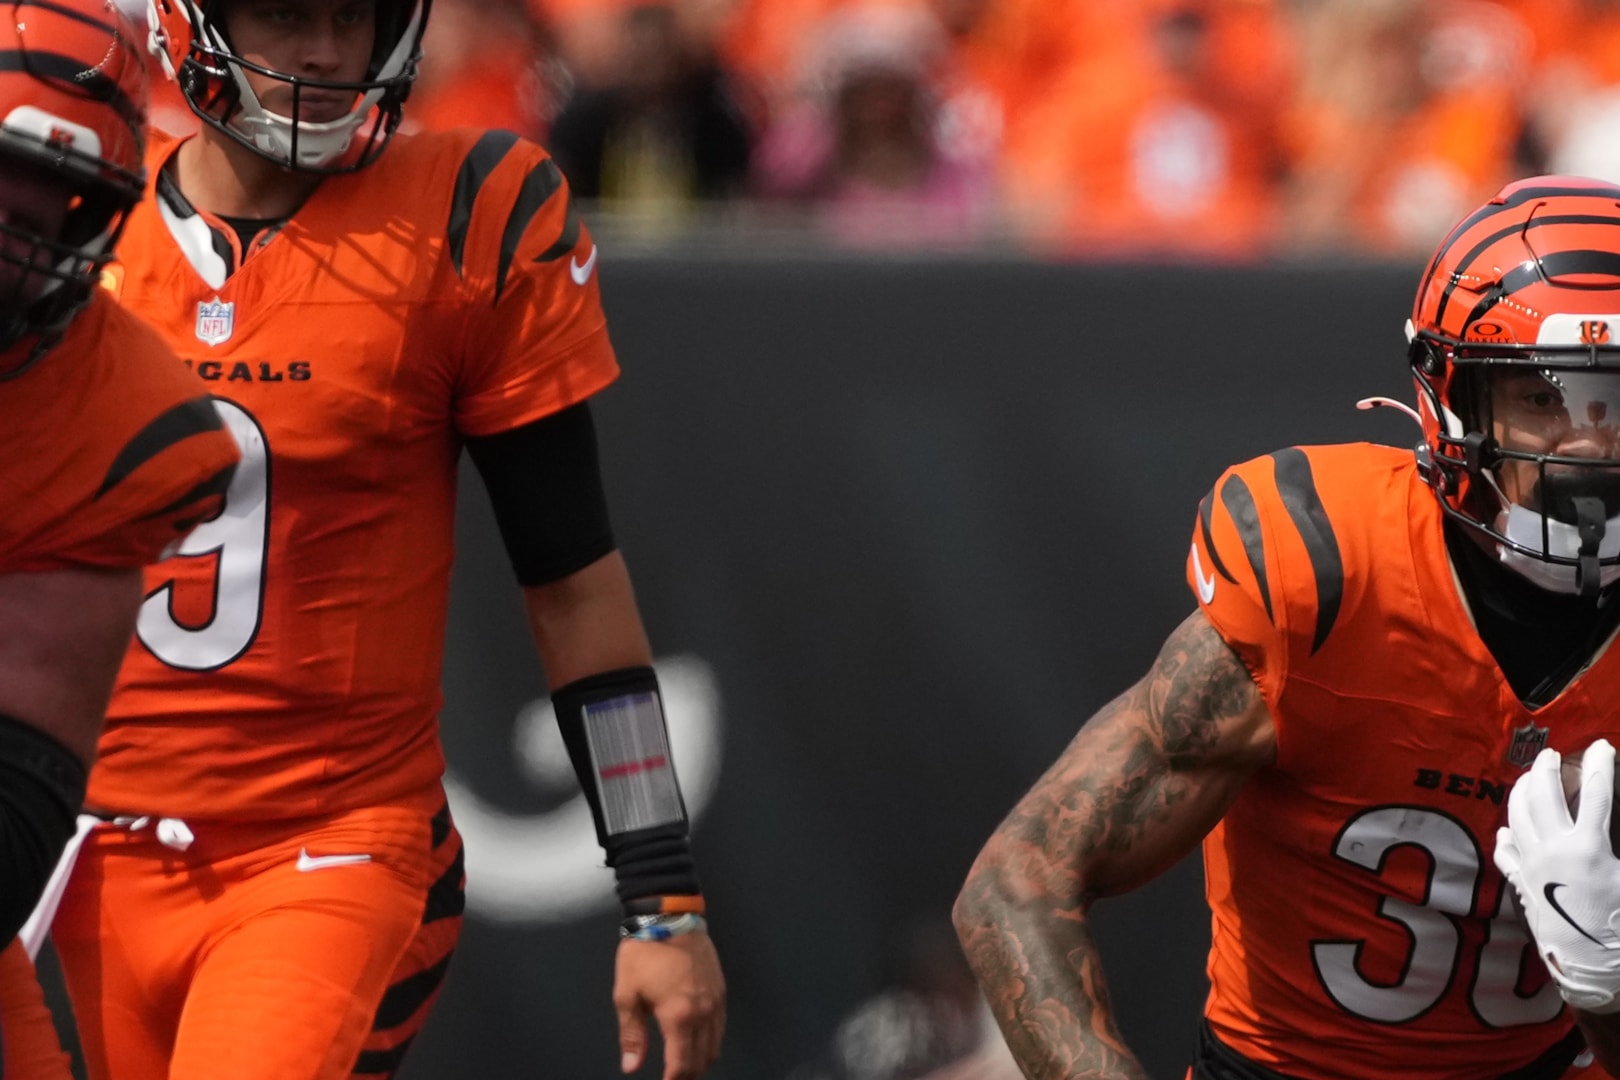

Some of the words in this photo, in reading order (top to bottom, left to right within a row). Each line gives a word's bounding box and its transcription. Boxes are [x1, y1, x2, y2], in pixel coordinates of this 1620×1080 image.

[184, 360, 311, 382] GALS
[136, 395, 272, 672] 9
[1413, 768, 1505, 806] BEN
